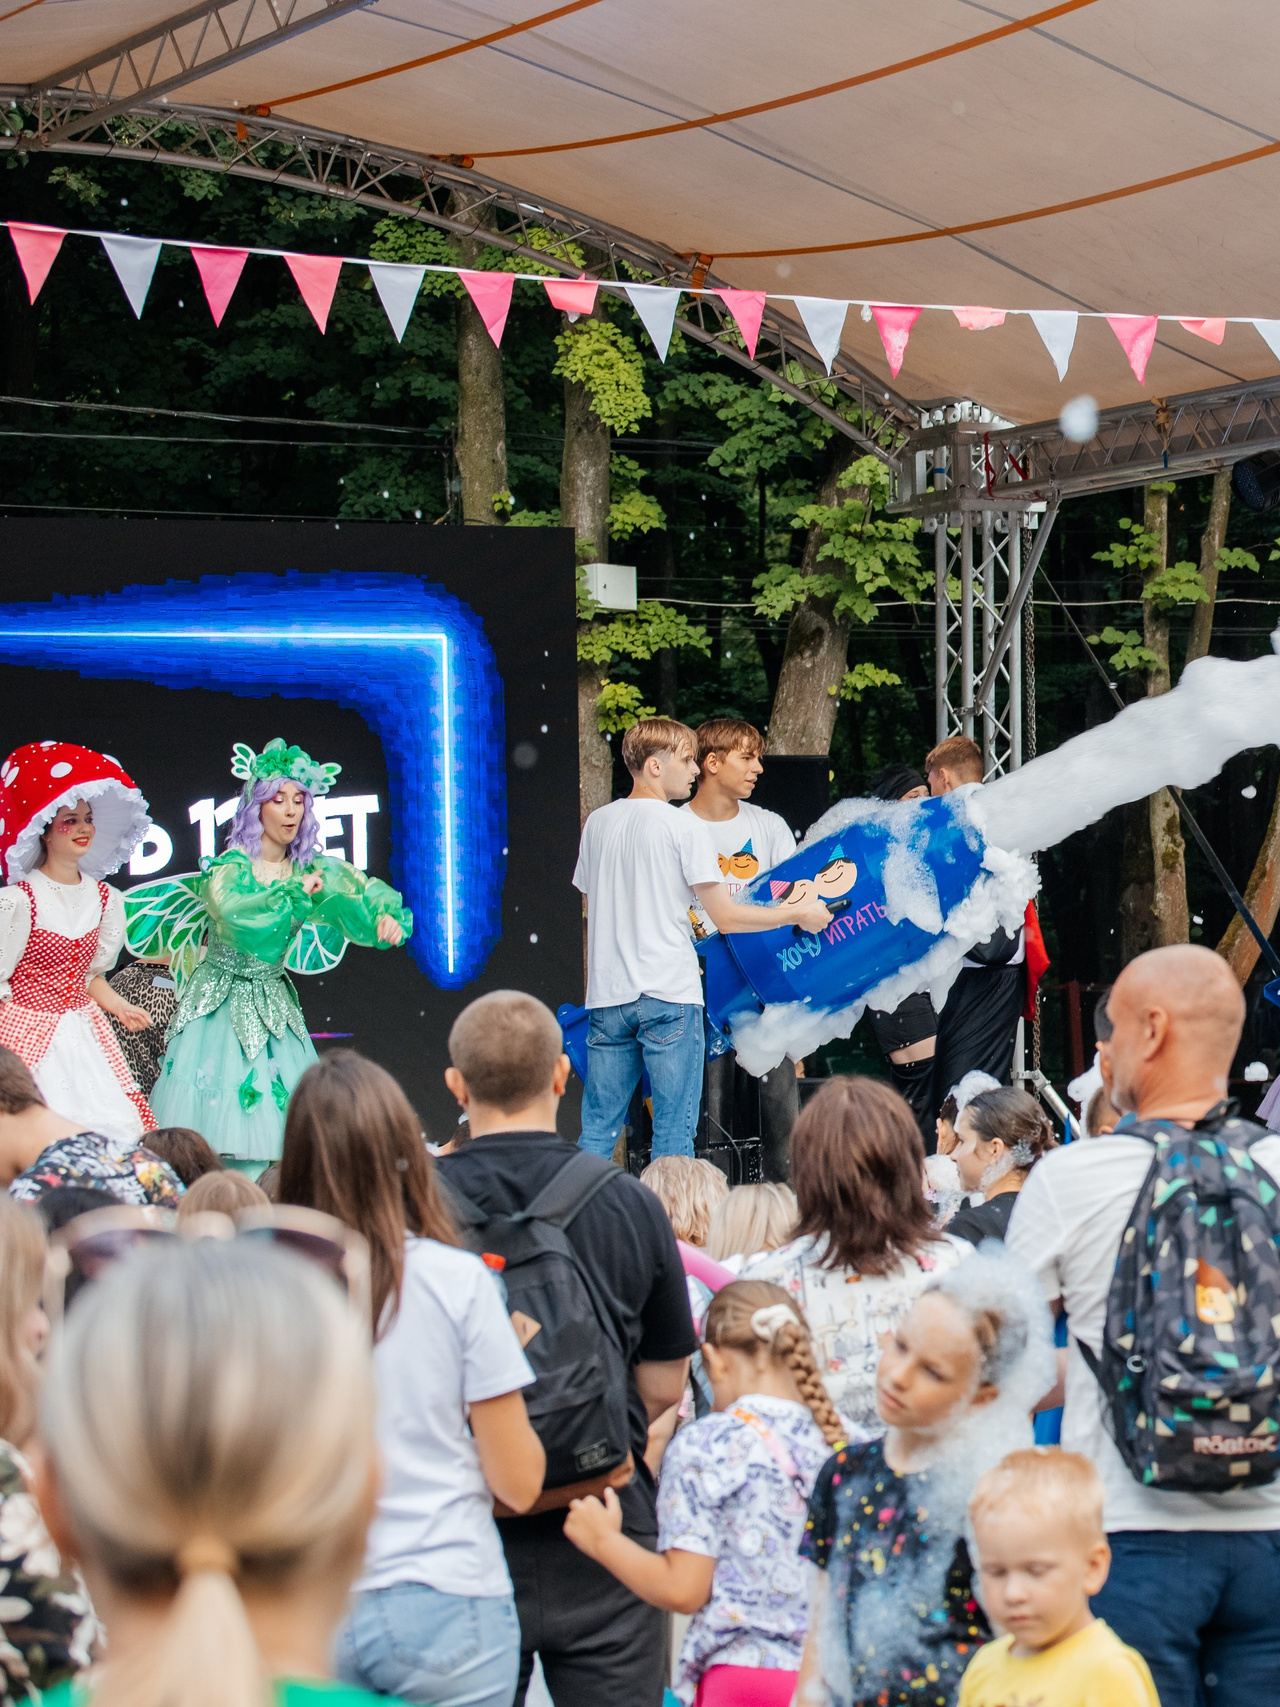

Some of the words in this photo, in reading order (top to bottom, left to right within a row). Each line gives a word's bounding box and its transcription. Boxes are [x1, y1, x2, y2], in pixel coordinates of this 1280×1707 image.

[312, 794, 380, 871] ЕТ
[776, 933, 821, 972] ХОЧУ
[823, 901, 888, 946] ИГРАТЬ
